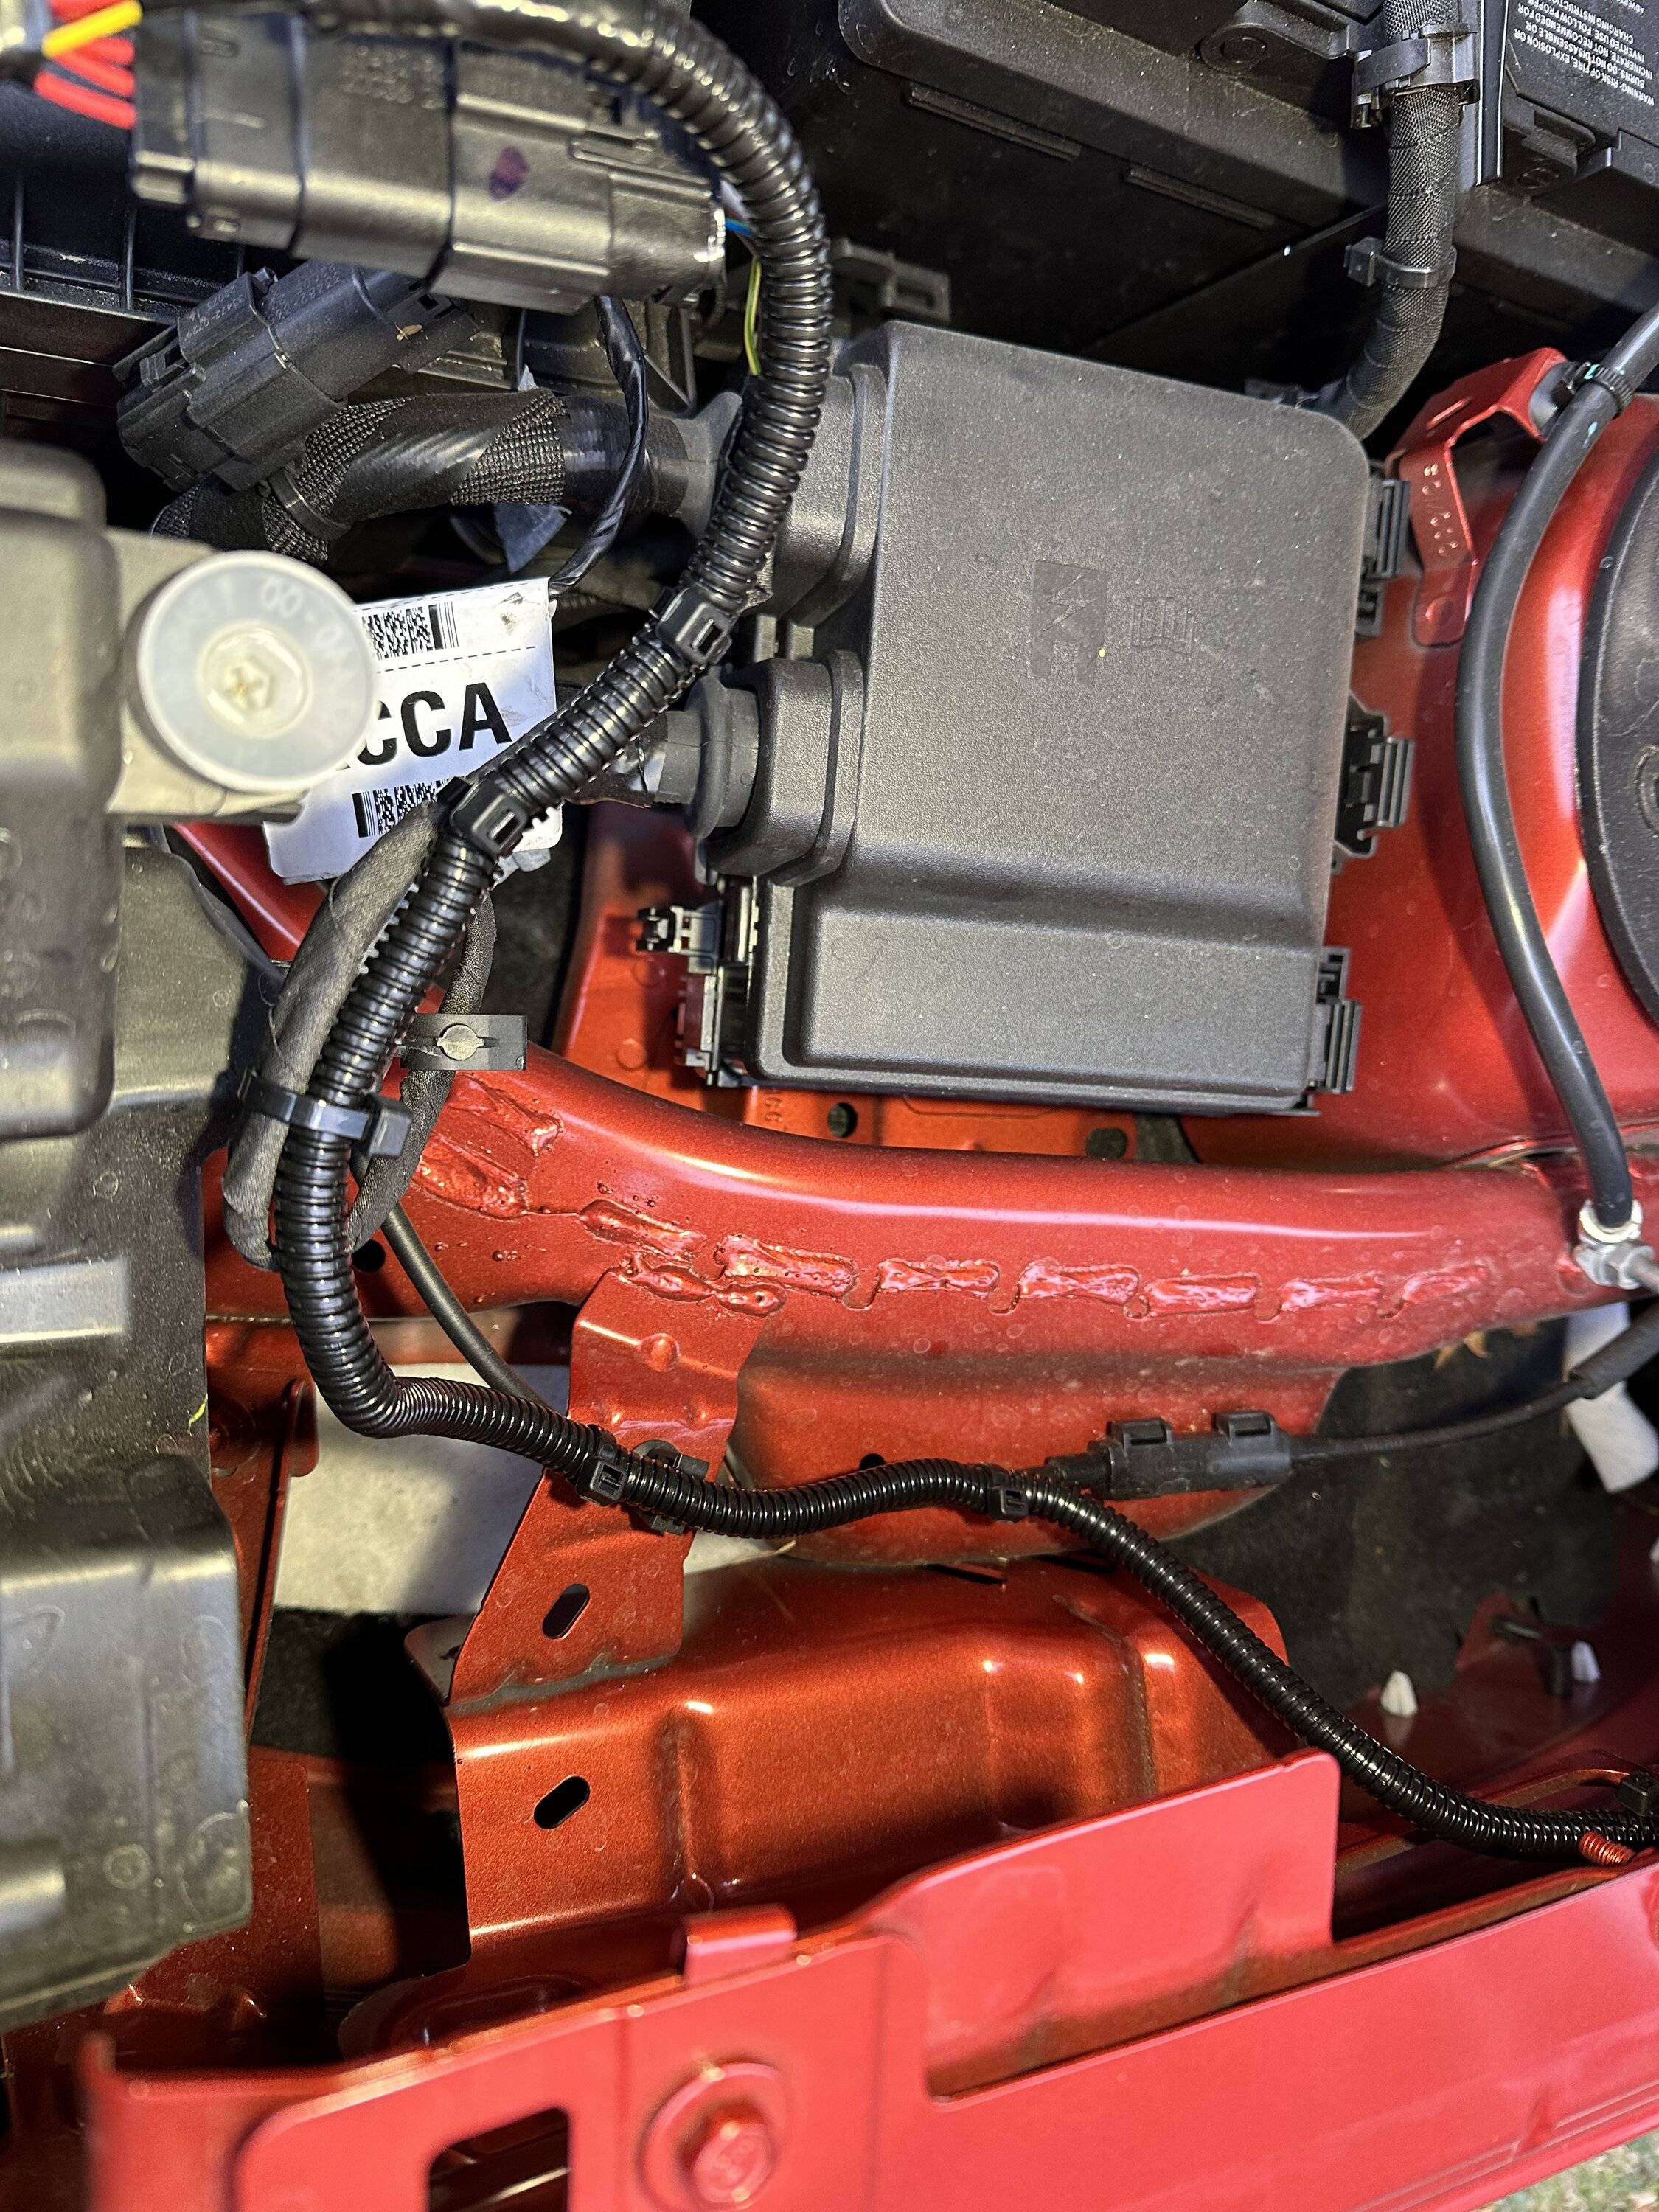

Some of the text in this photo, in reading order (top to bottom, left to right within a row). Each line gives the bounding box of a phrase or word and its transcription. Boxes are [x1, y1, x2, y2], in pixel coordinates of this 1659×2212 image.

[1517, 3, 1534, 20] FOR
[1526, 21, 1537, 34] OR
[1534, 13, 1593, 49] RECOMMENDED
[1559, 12, 1592, 35] FOLLOW
[1596, 18, 1634, 45] CHARGING
[1538, 27, 1591, 60] DISASSEMBLE
[1593, 28, 1609, 44] USE.
[1593, 43, 1609, 57] NOT
[1610, 38, 1644, 63] INVERTED
[1514, 28, 1655, 106] WARNING: RISK OF FIRE, EXPLOSION OR
[1592, 55, 1606, 69] NOT
[1607, 63, 1618, 74] DO
[336, 682, 512, 771] CCA
